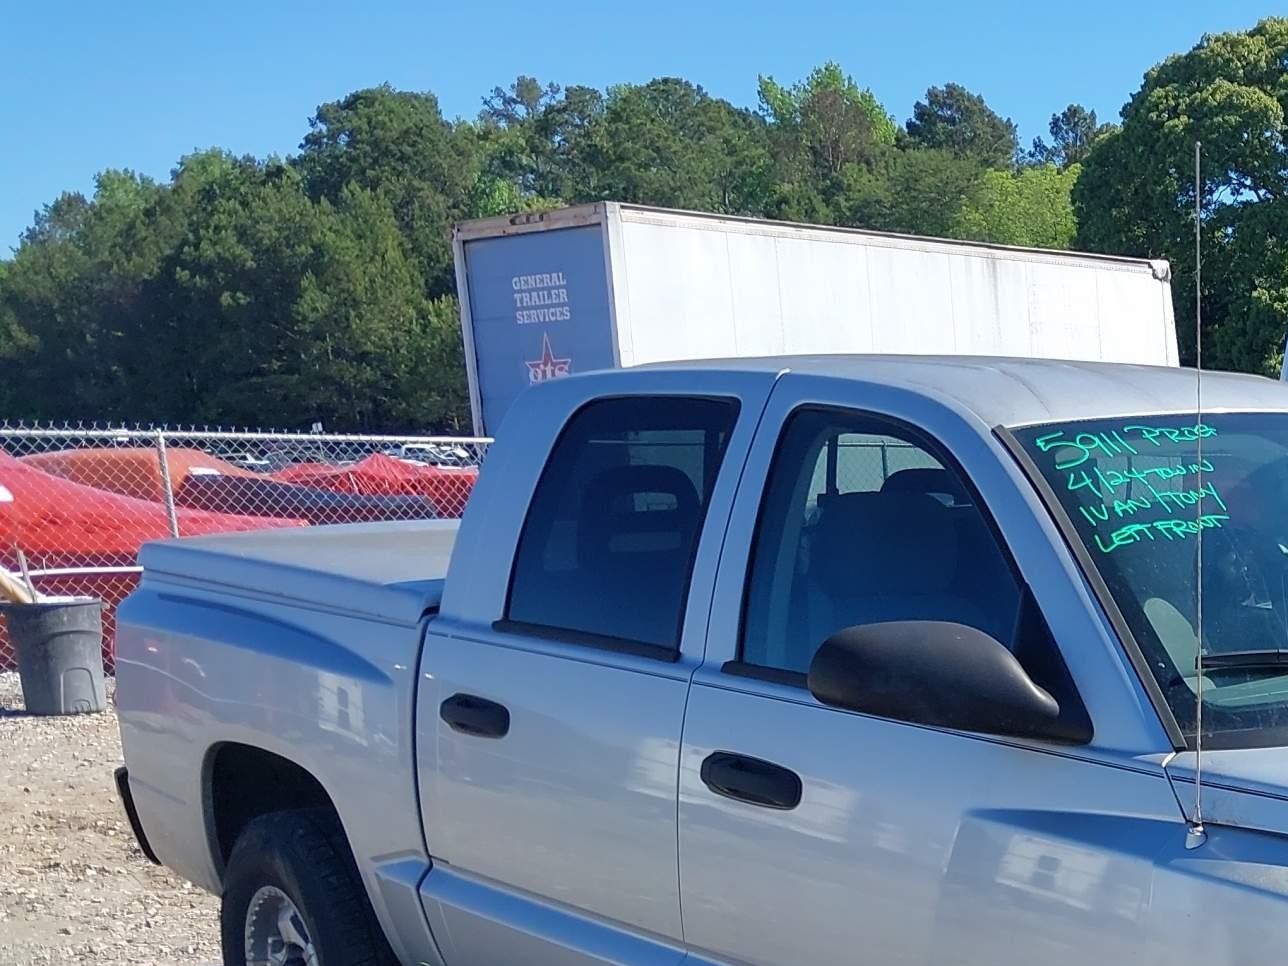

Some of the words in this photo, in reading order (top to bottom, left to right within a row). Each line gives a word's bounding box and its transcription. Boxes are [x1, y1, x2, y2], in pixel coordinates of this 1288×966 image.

[511, 272, 567, 290] GENERAL
[513, 288, 569, 307] TRAILER
[515, 306, 571, 325] SERVICES
